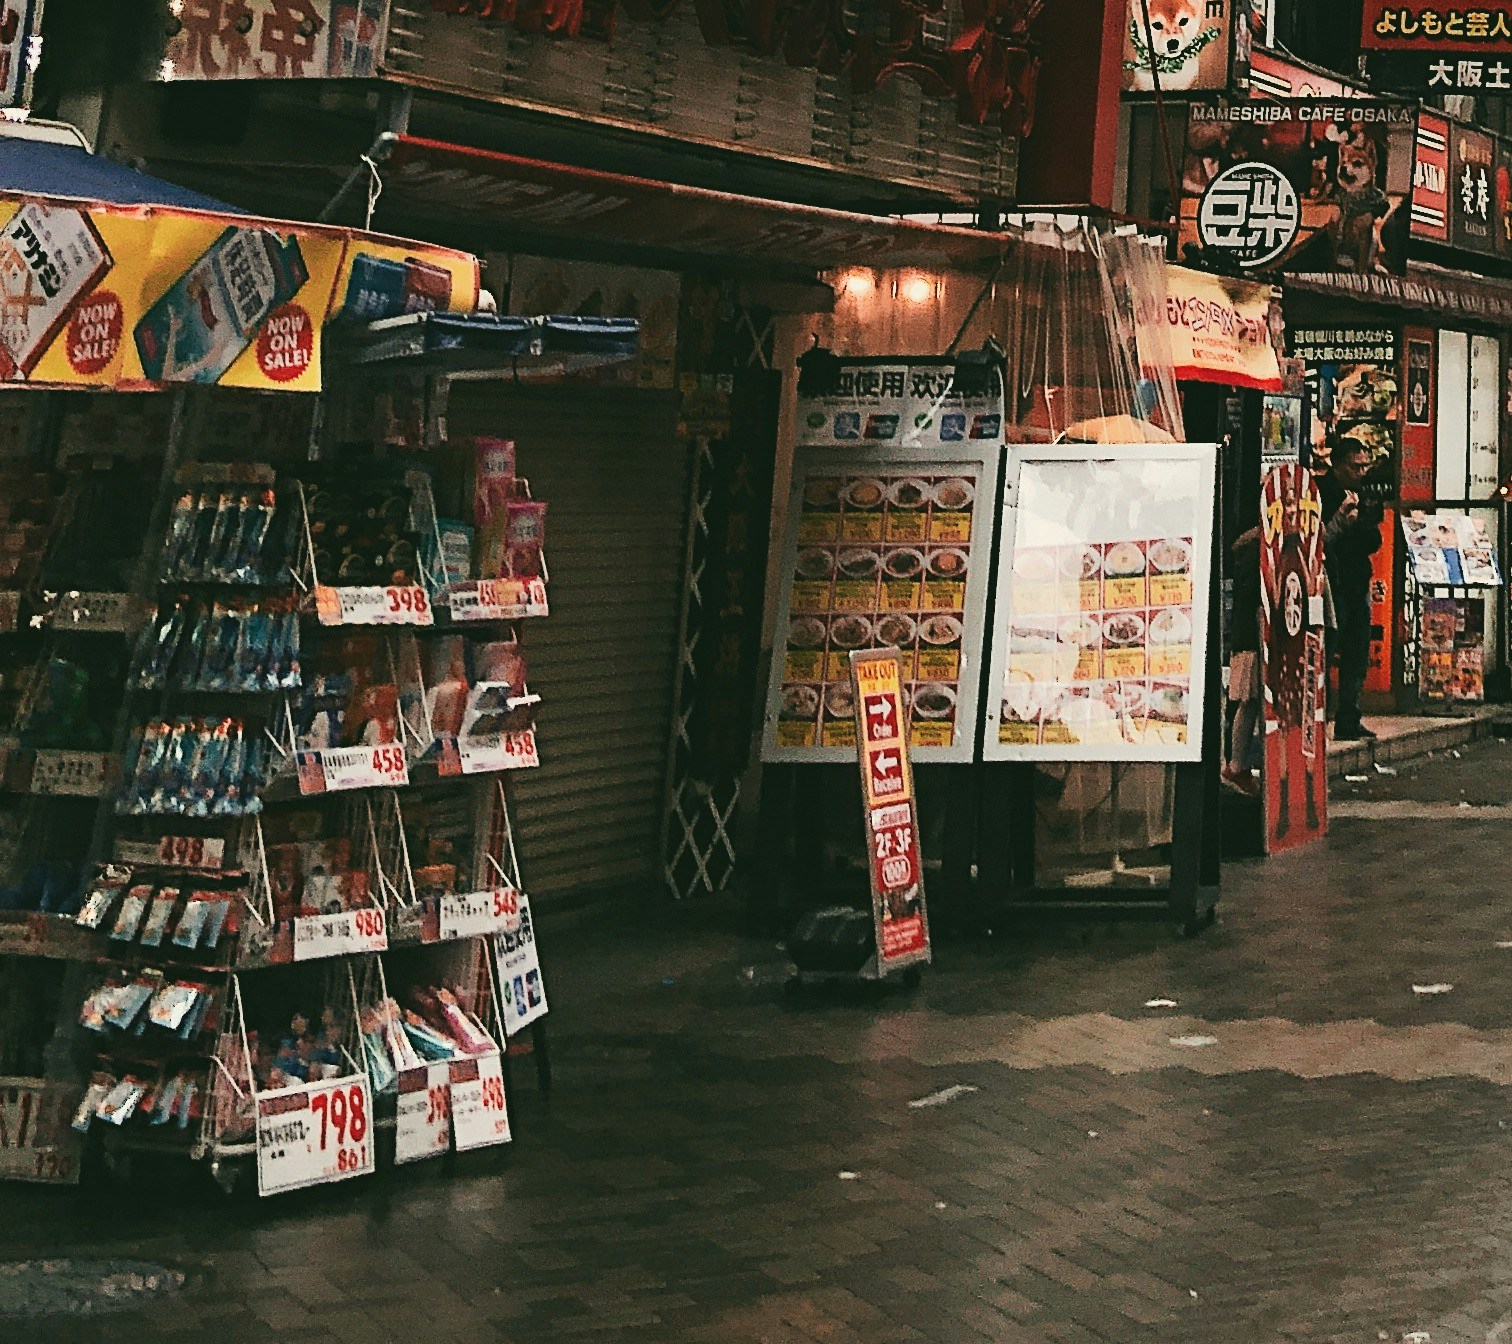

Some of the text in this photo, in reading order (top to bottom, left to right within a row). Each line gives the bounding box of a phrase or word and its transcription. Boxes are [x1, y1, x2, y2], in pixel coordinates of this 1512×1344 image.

[1192, 106, 1412, 124] MAMESHIBA CAFE OSAKA
[78, 302, 118, 324] NOW
[81, 322, 110, 342] ON
[267, 314, 305, 336] NOW
[72, 339, 117, 362] SALE!
[270, 335, 298, 352] ON
[264, 347, 309, 370] SALE!
[386, 588, 428, 614] 398
[879, 660, 898, 680] OUT
[504, 731, 535, 757] 458
[372, 747, 405, 775] 458
[355, 908, 384, 938] 980
[311, 1083, 368, 1151] 798
